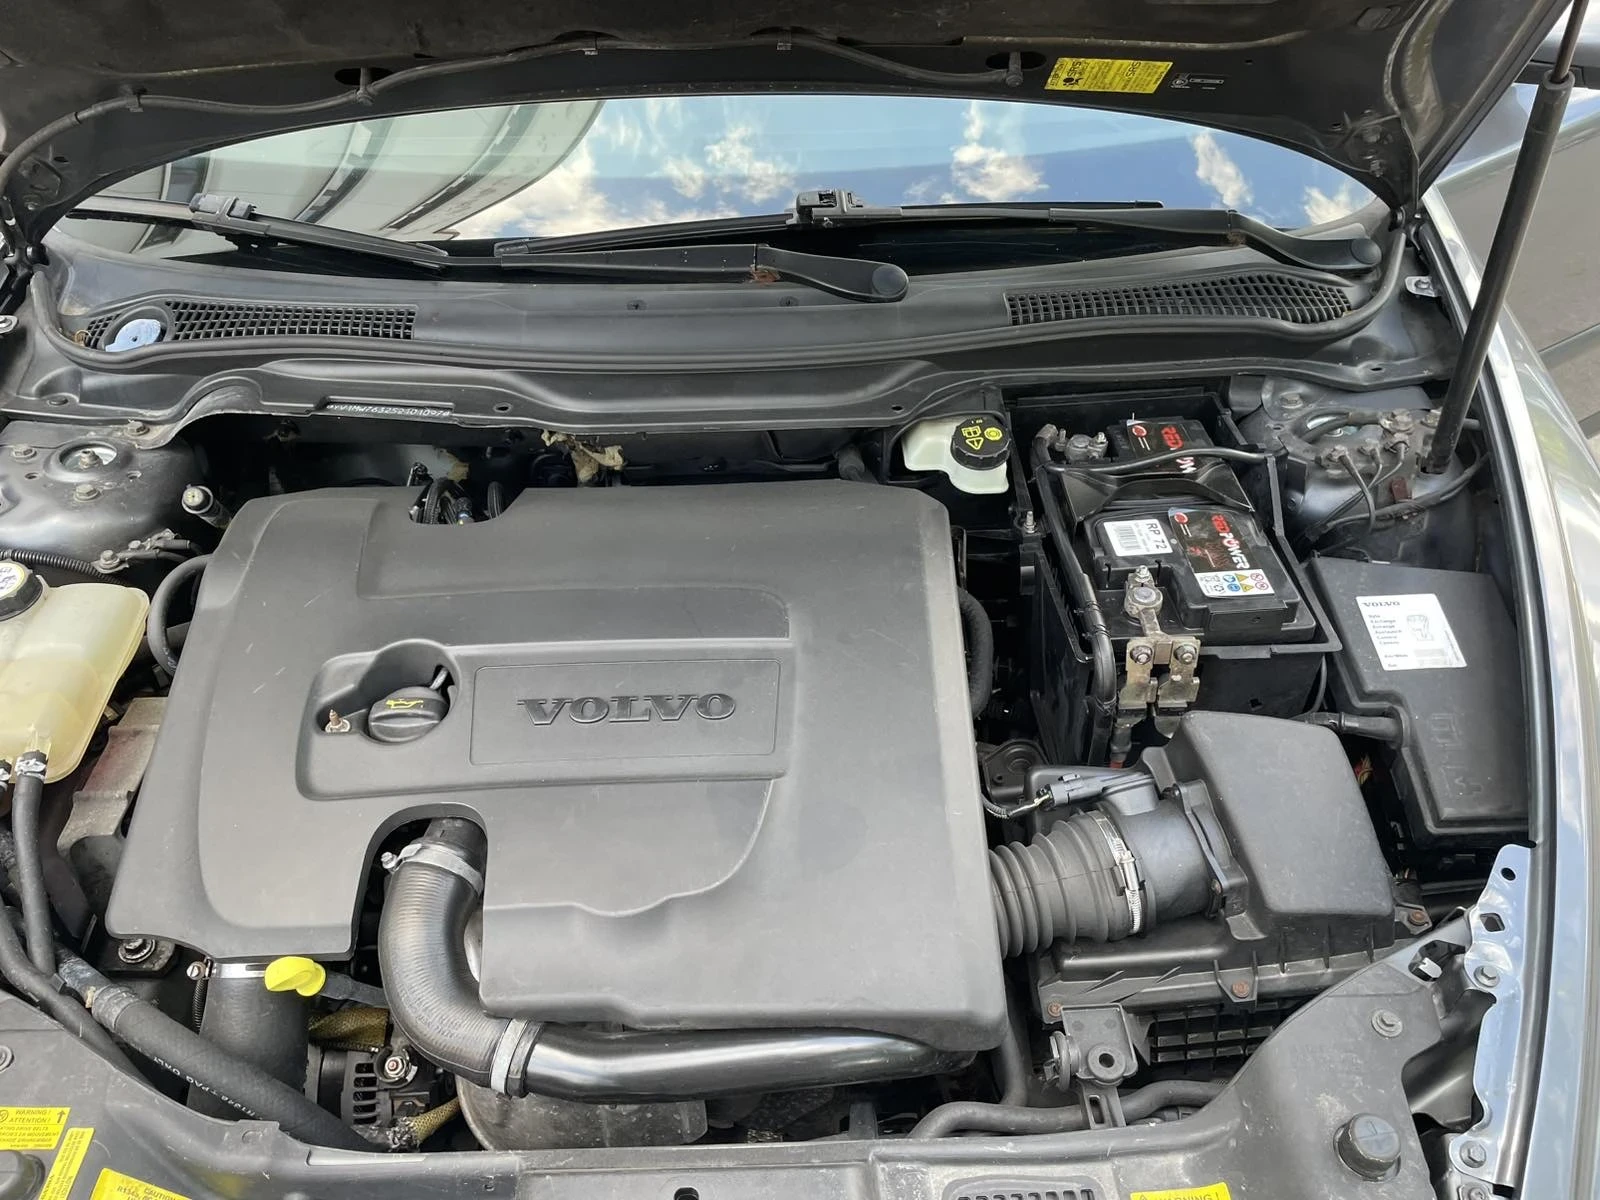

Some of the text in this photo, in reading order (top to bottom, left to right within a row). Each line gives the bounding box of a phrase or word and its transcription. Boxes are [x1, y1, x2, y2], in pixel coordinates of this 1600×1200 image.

[1068, 61, 1082, 77] SRS
[1125, 62, 1141, 77] SRS
[1146, 523, 1167, 549] RP 72
[516, 693, 737, 726] VOLVO
